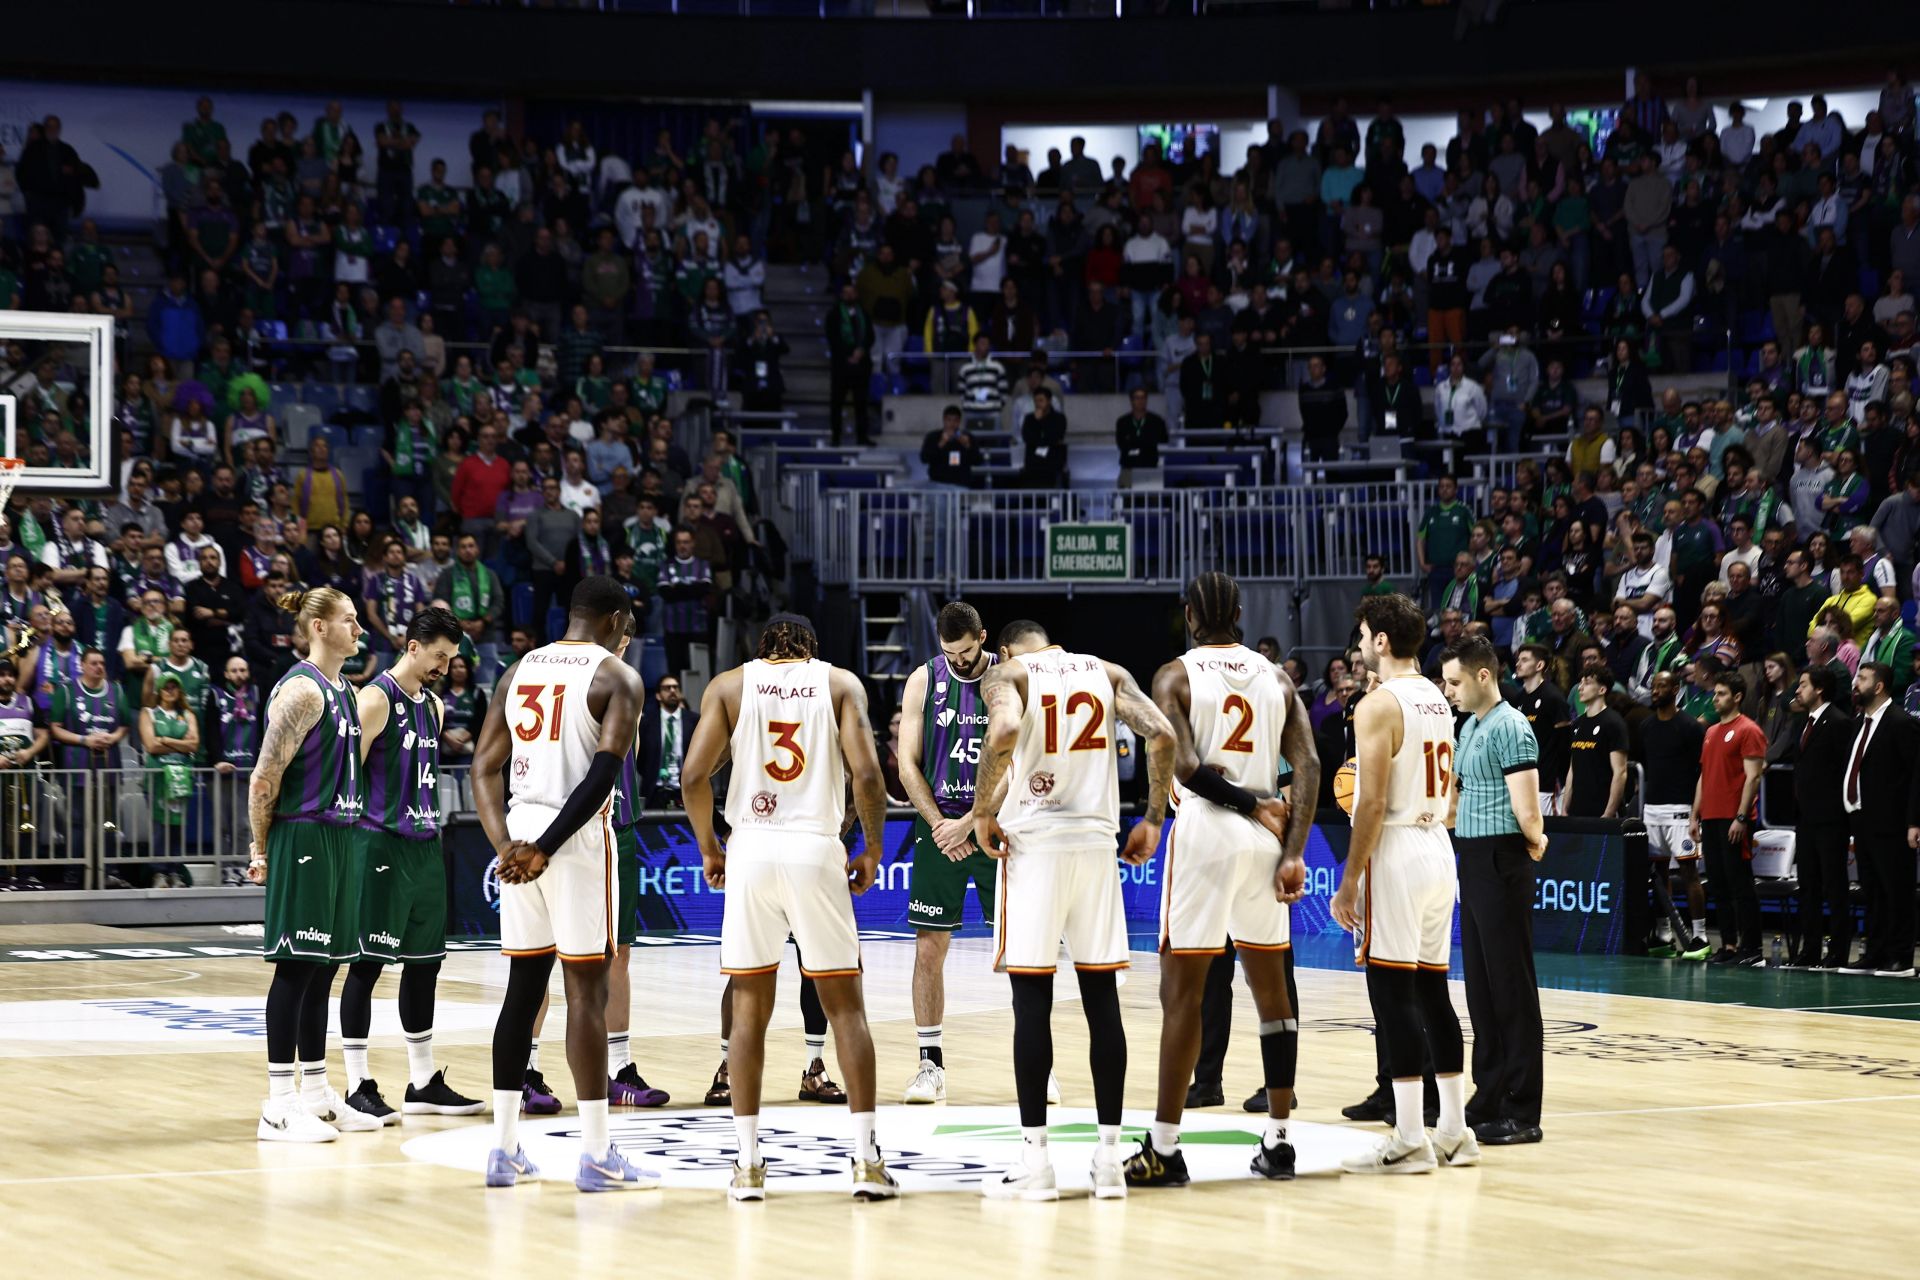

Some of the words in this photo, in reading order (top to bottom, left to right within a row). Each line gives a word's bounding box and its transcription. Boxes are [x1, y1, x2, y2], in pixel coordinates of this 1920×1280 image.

[1056, 534, 1097, 551] SALIDA
[1105, 534, 1119, 551] DE
[1052, 554, 1124, 571] EMERGENCIA
[526, 654, 589, 666] DELGADO
[515, 684, 566, 742] 31
[957, 713, 989, 725] Unica
[1041, 691, 1107, 755] 12
[1221, 693, 1254, 753] 2
[764, 721, 806, 783] 3
[950, 738, 982, 764] 45
[350, 752, 354, 781] 1
[418, 762, 436, 789] 14
[1423, 740, 1452, 798] 19
[1116, 857, 1157, 885] GUE
